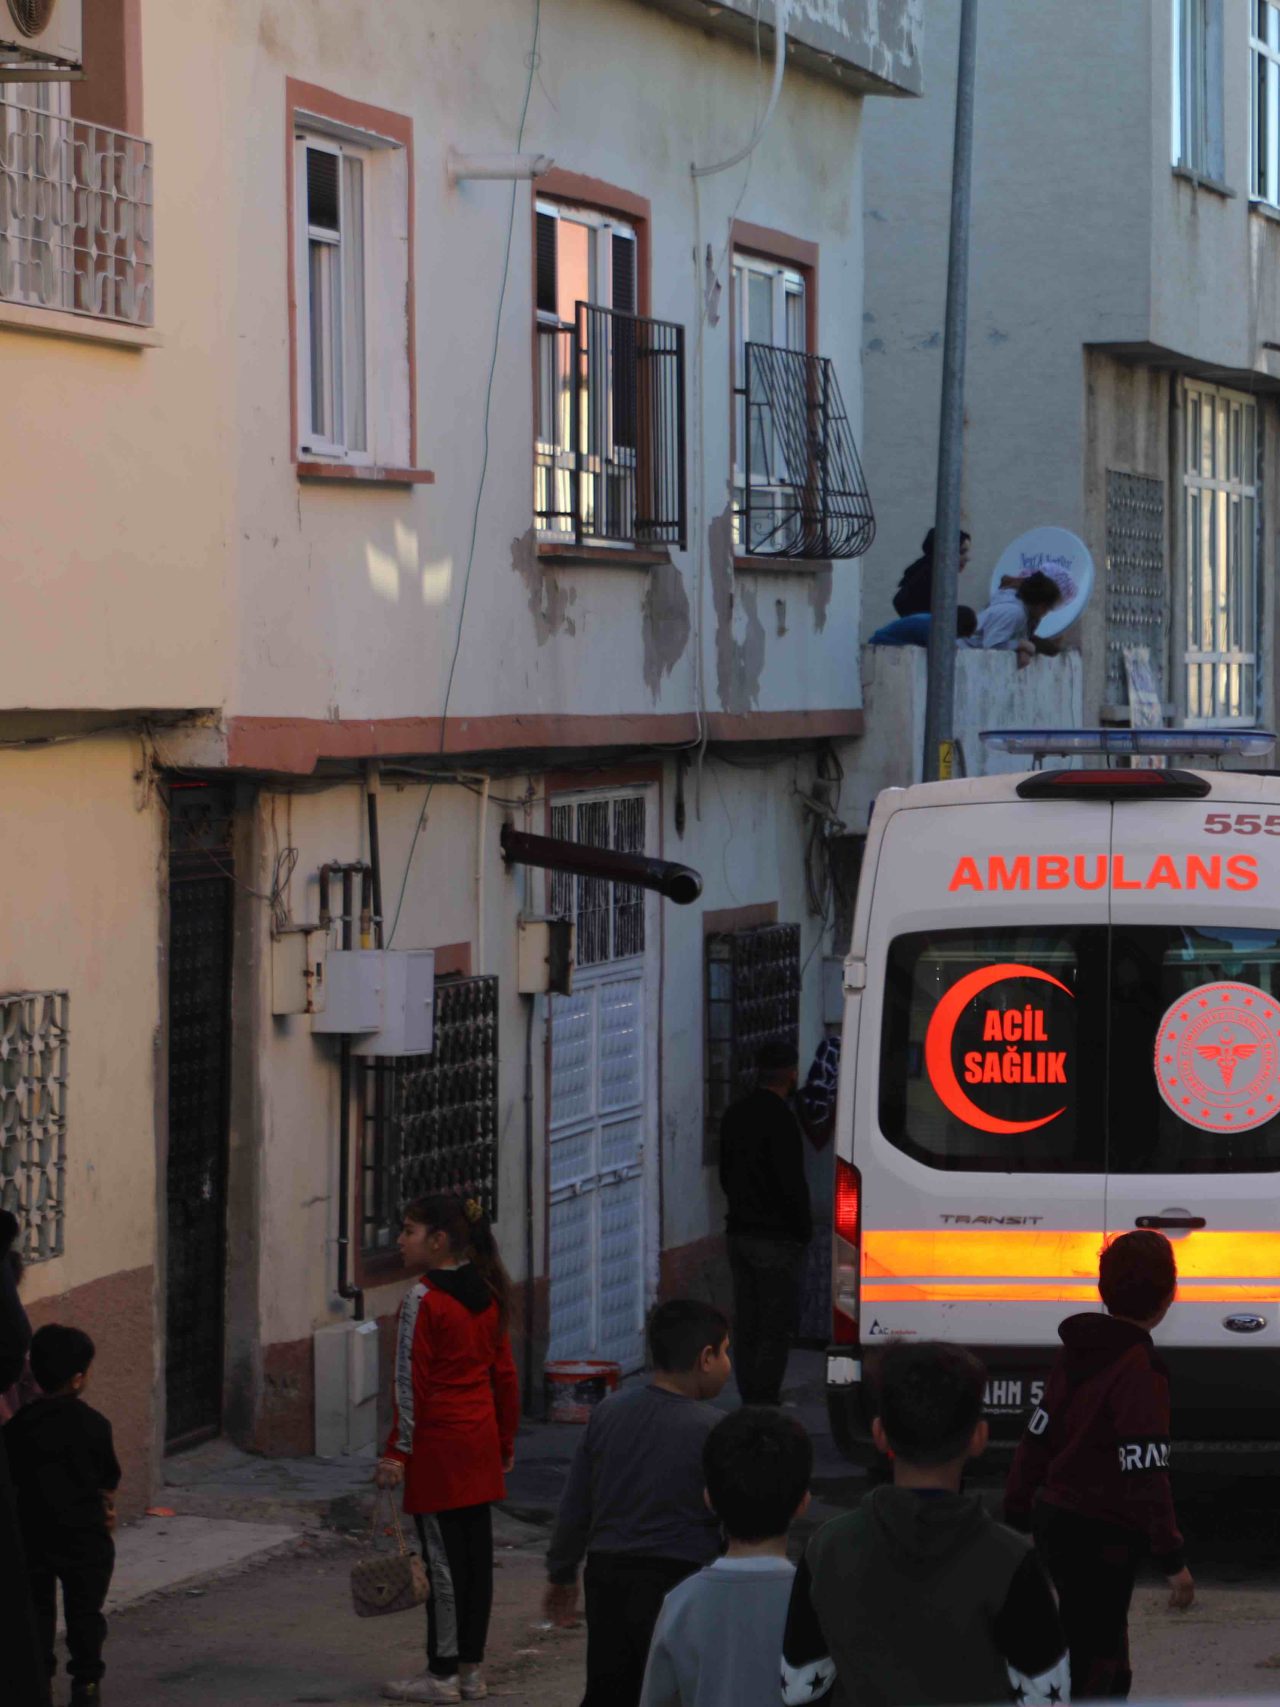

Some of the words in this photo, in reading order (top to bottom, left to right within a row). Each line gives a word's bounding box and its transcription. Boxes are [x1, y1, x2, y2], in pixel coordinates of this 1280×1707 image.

[947, 853, 1260, 892] AMBULANS
[983, 1003, 1048, 1042] ACİL
[964, 1044, 1068, 1084] SAĞLIK
[940, 1214, 1044, 1225] TRANSIT
